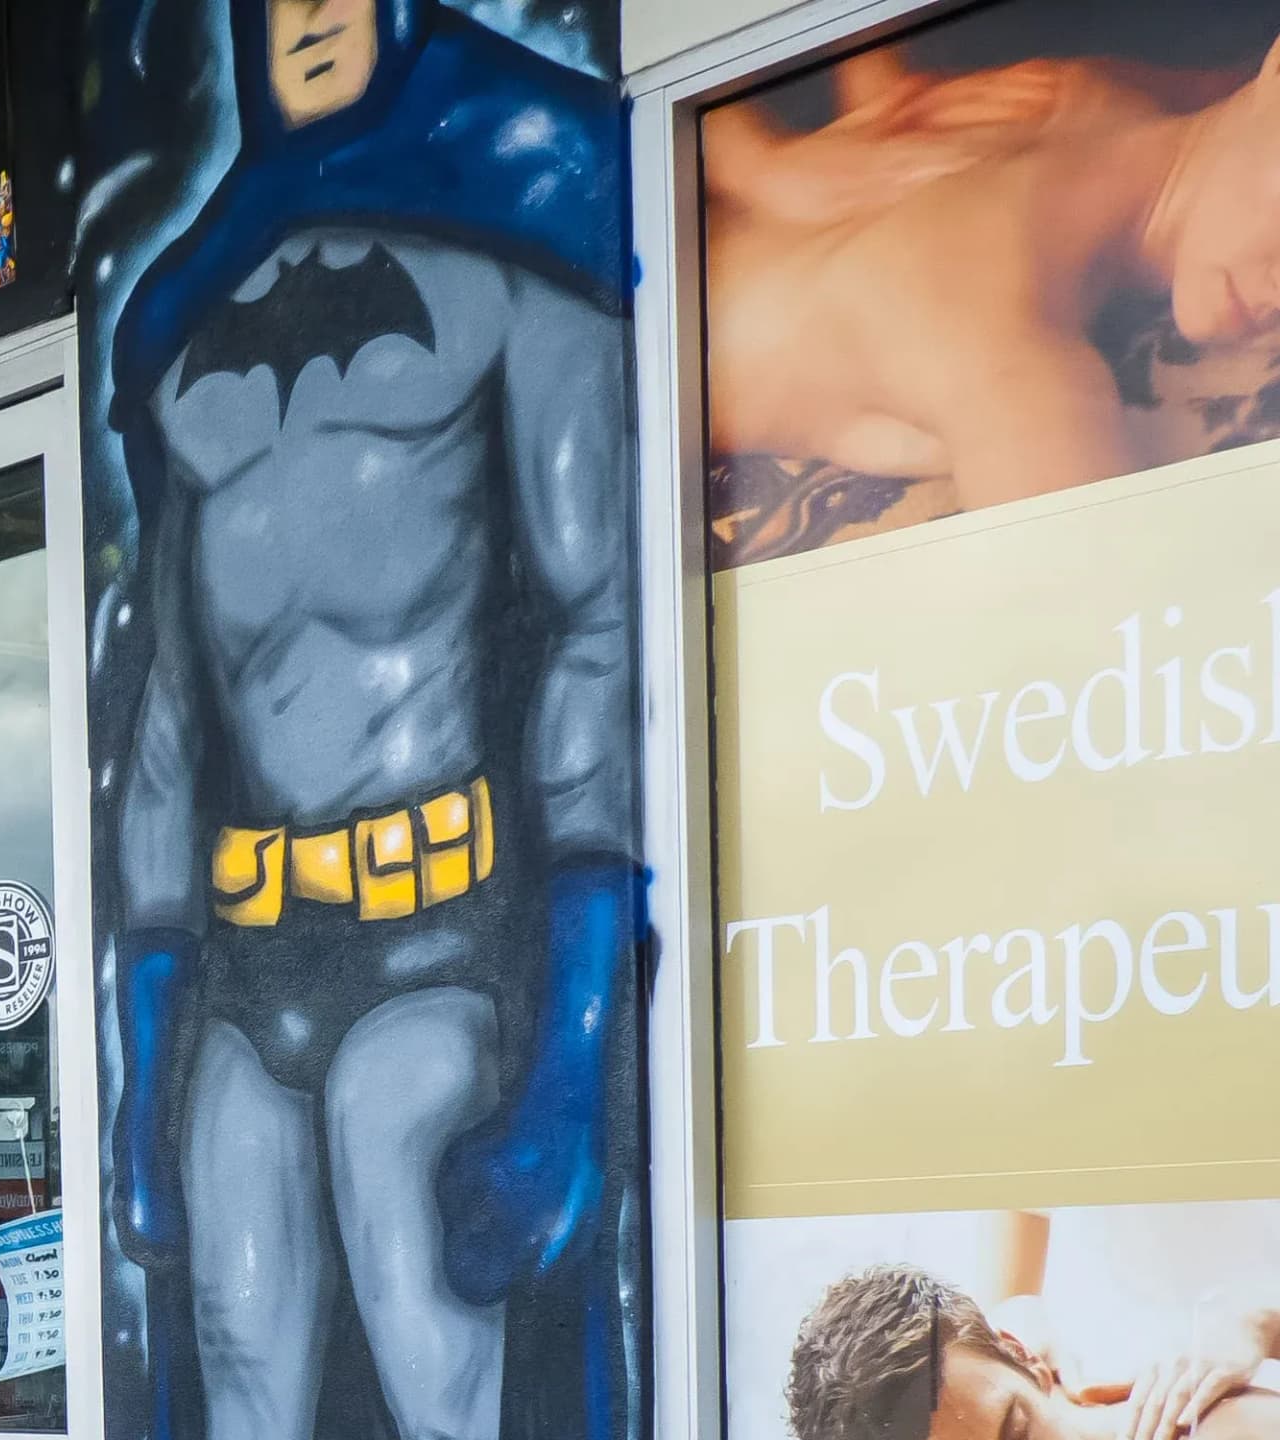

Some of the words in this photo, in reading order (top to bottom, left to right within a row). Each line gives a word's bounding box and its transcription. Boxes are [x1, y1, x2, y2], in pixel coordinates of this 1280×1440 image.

[23, 942, 47, 958] 1994
[6, 963, 44, 1014] RESELLER
[726, 903, 1280, 1068] Therapeu
[10, 1272, 29, 1288] TUE
[15, 1291, 34, 1306] WED
